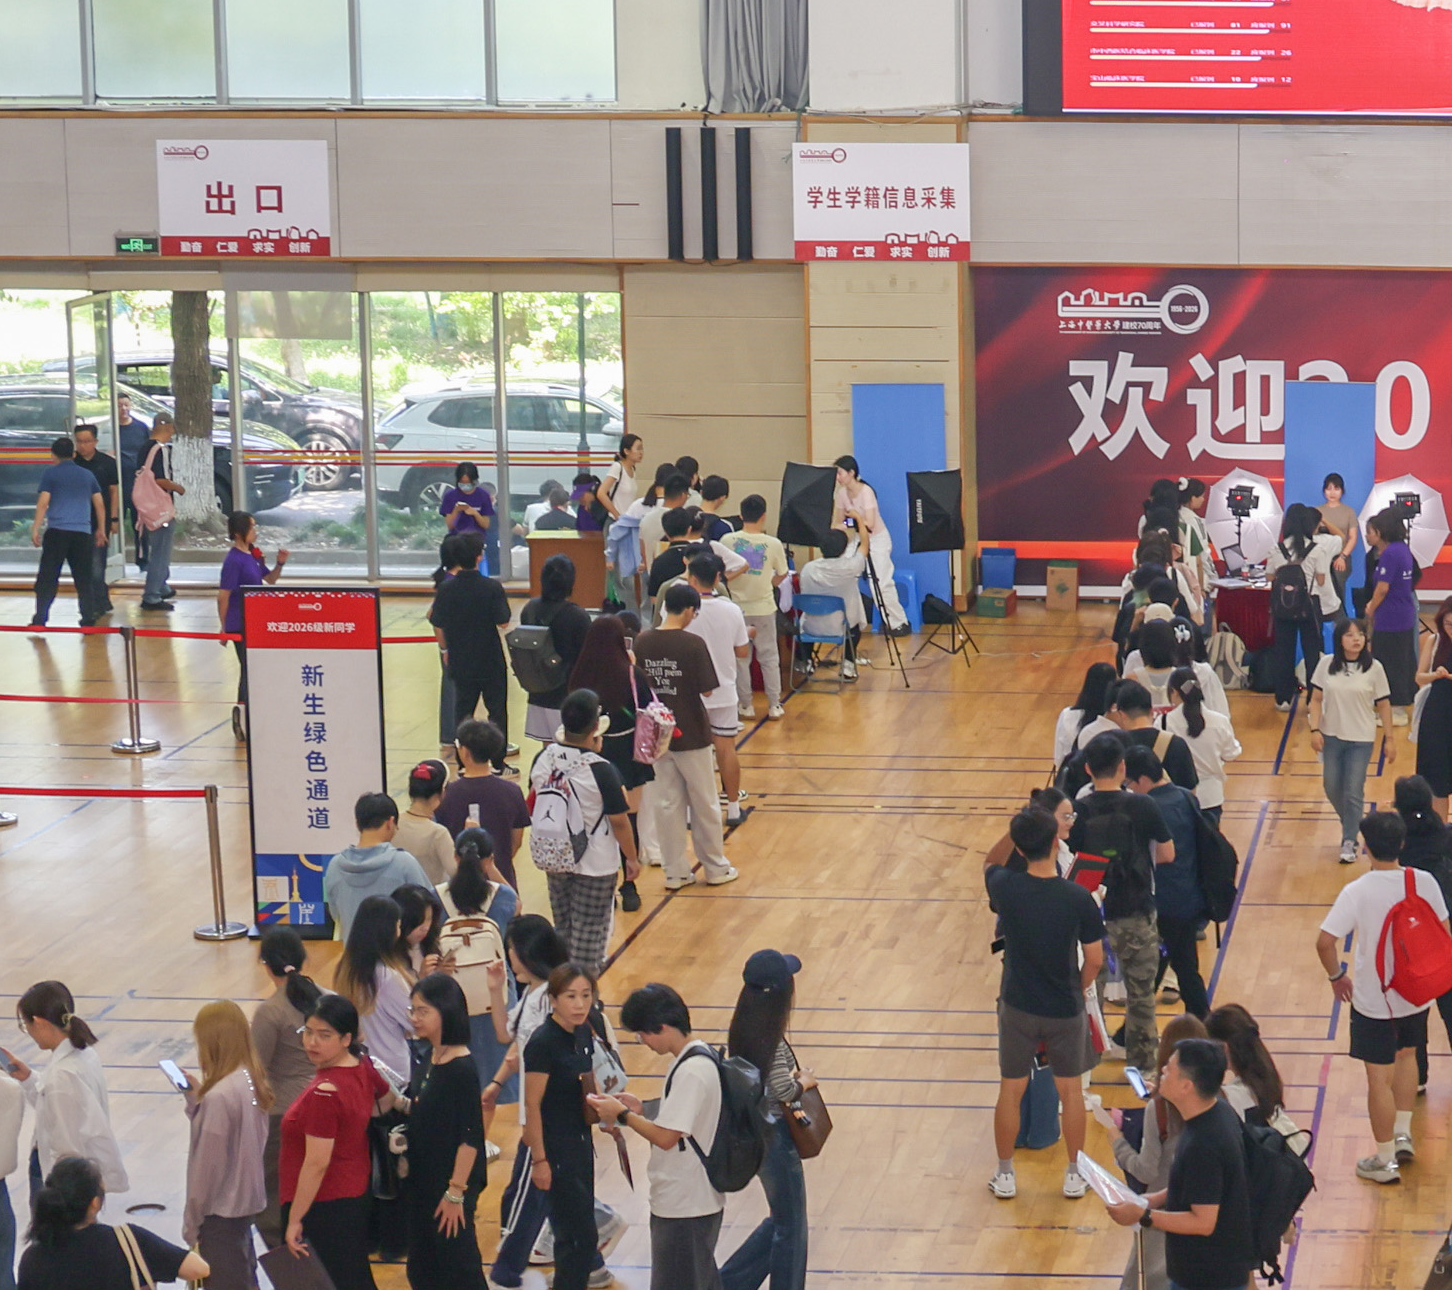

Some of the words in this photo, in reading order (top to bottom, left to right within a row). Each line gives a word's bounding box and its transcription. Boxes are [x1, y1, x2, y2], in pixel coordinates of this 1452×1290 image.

[205, 181, 283, 215] 出口
[807, 186, 956, 209] 学生学籍信息采集
[179, 241, 202, 253] 勤奋
[216, 241, 239, 253] 仁爱
[252, 241, 275, 253] 求实
[289, 241, 311, 253] 创新
[815, 246, 838, 258] 勤奋
[852, 246, 875, 258] 仁爱
[890, 246, 913, 258] 求实
[927, 246, 950, 258] 创新
[266, 621, 356, 634] 欢迎2026级新同学
[301, 664, 331, 830] 新生绿色通道
